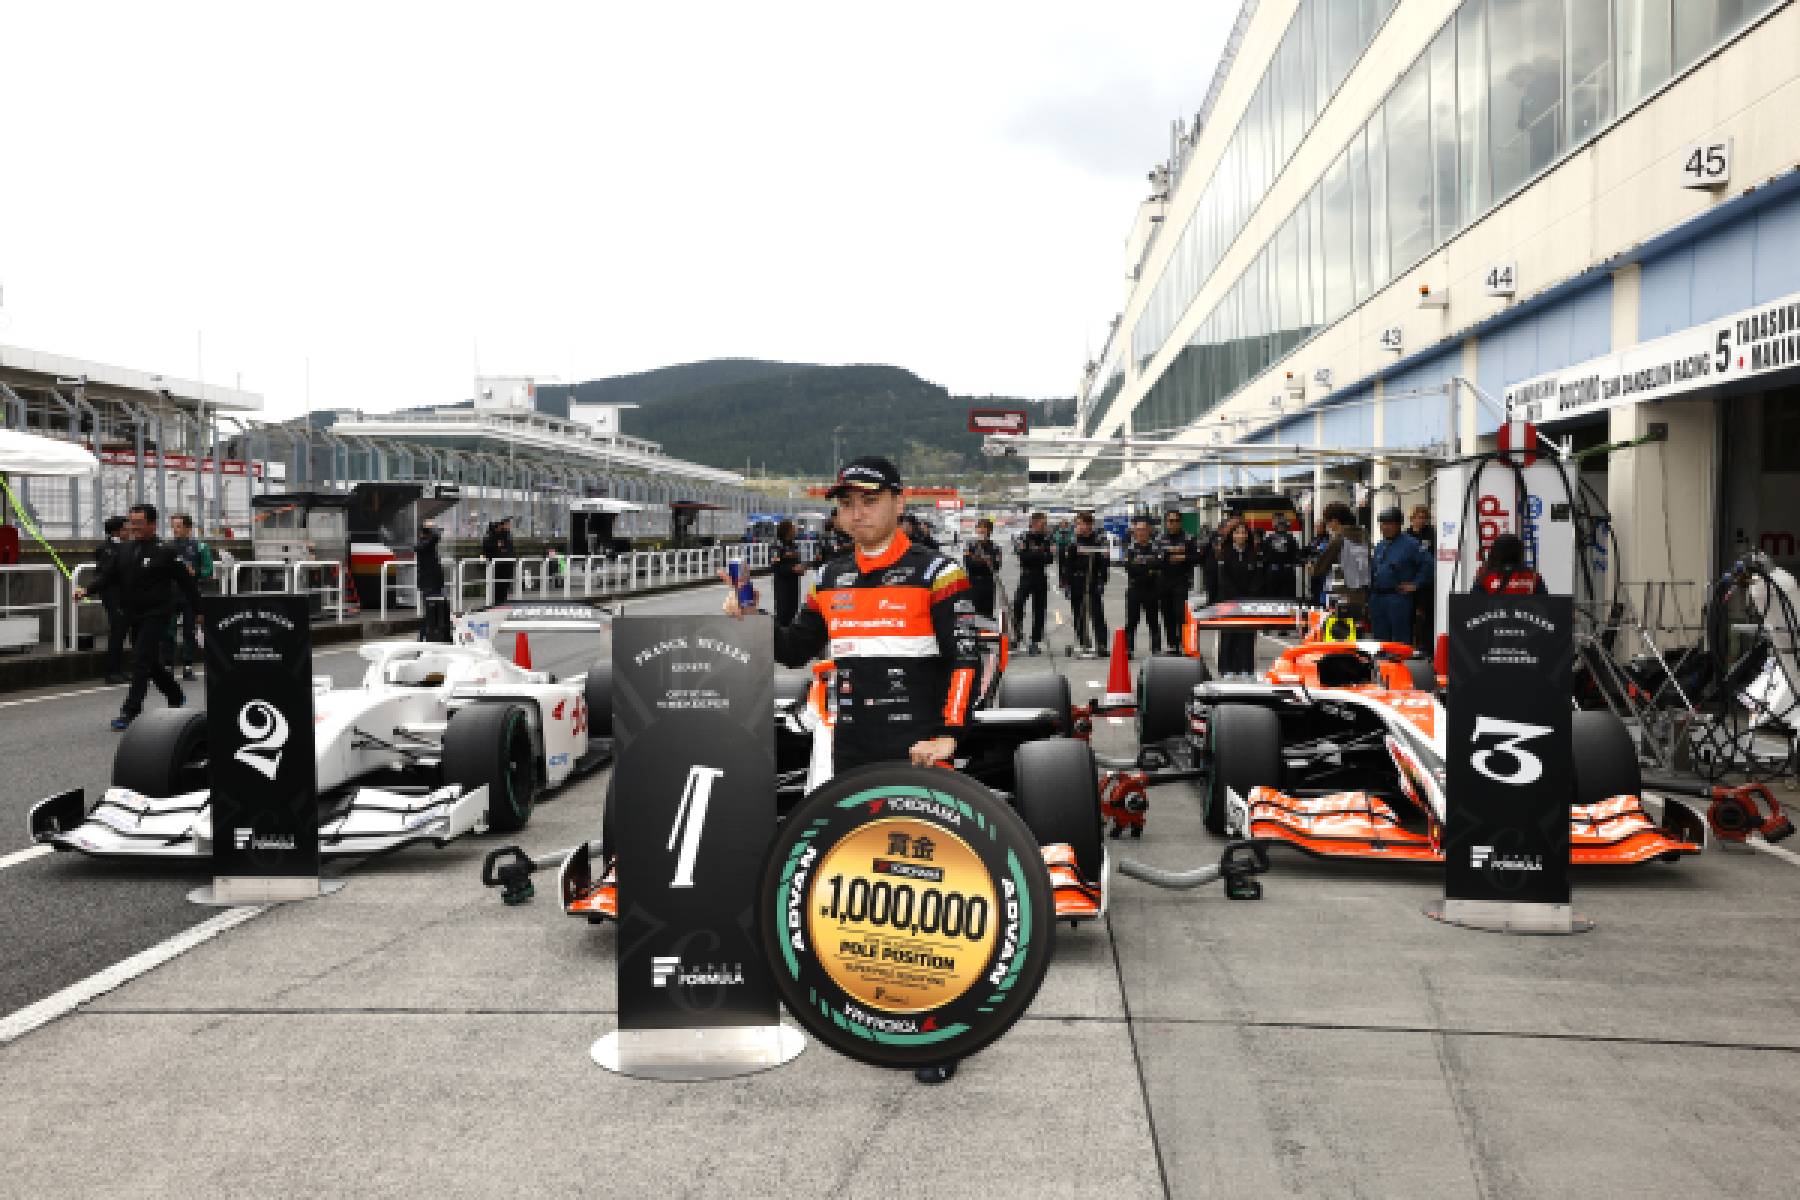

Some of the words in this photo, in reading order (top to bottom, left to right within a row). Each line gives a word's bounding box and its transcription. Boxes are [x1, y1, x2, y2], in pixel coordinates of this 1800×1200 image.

[1685, 145, 1726, 178] 45
[1487, 266, 1513, 288] 44
[1381, 328, 1401, 347] 43
[1715, 328, 1732, 373] 5
[1674, 350, 1711, 386] RACING
[233, 698, 290, 780] 2
[1468, 716, 1555, 785] 3
[667, 764, 724, 888] 1
[888, 797, 962, 826] YOKOHAMA
[788, 845, 818, 953] ADVAN
[989, 877, 1019, 985] ADVAN
[840, 940, 879, 958] POLE
[882, 946, 955, 972] POSITION
[678, 974, 744, 986] FORMULA
[843, 1001, 919, 1034] YOKOHAMA
